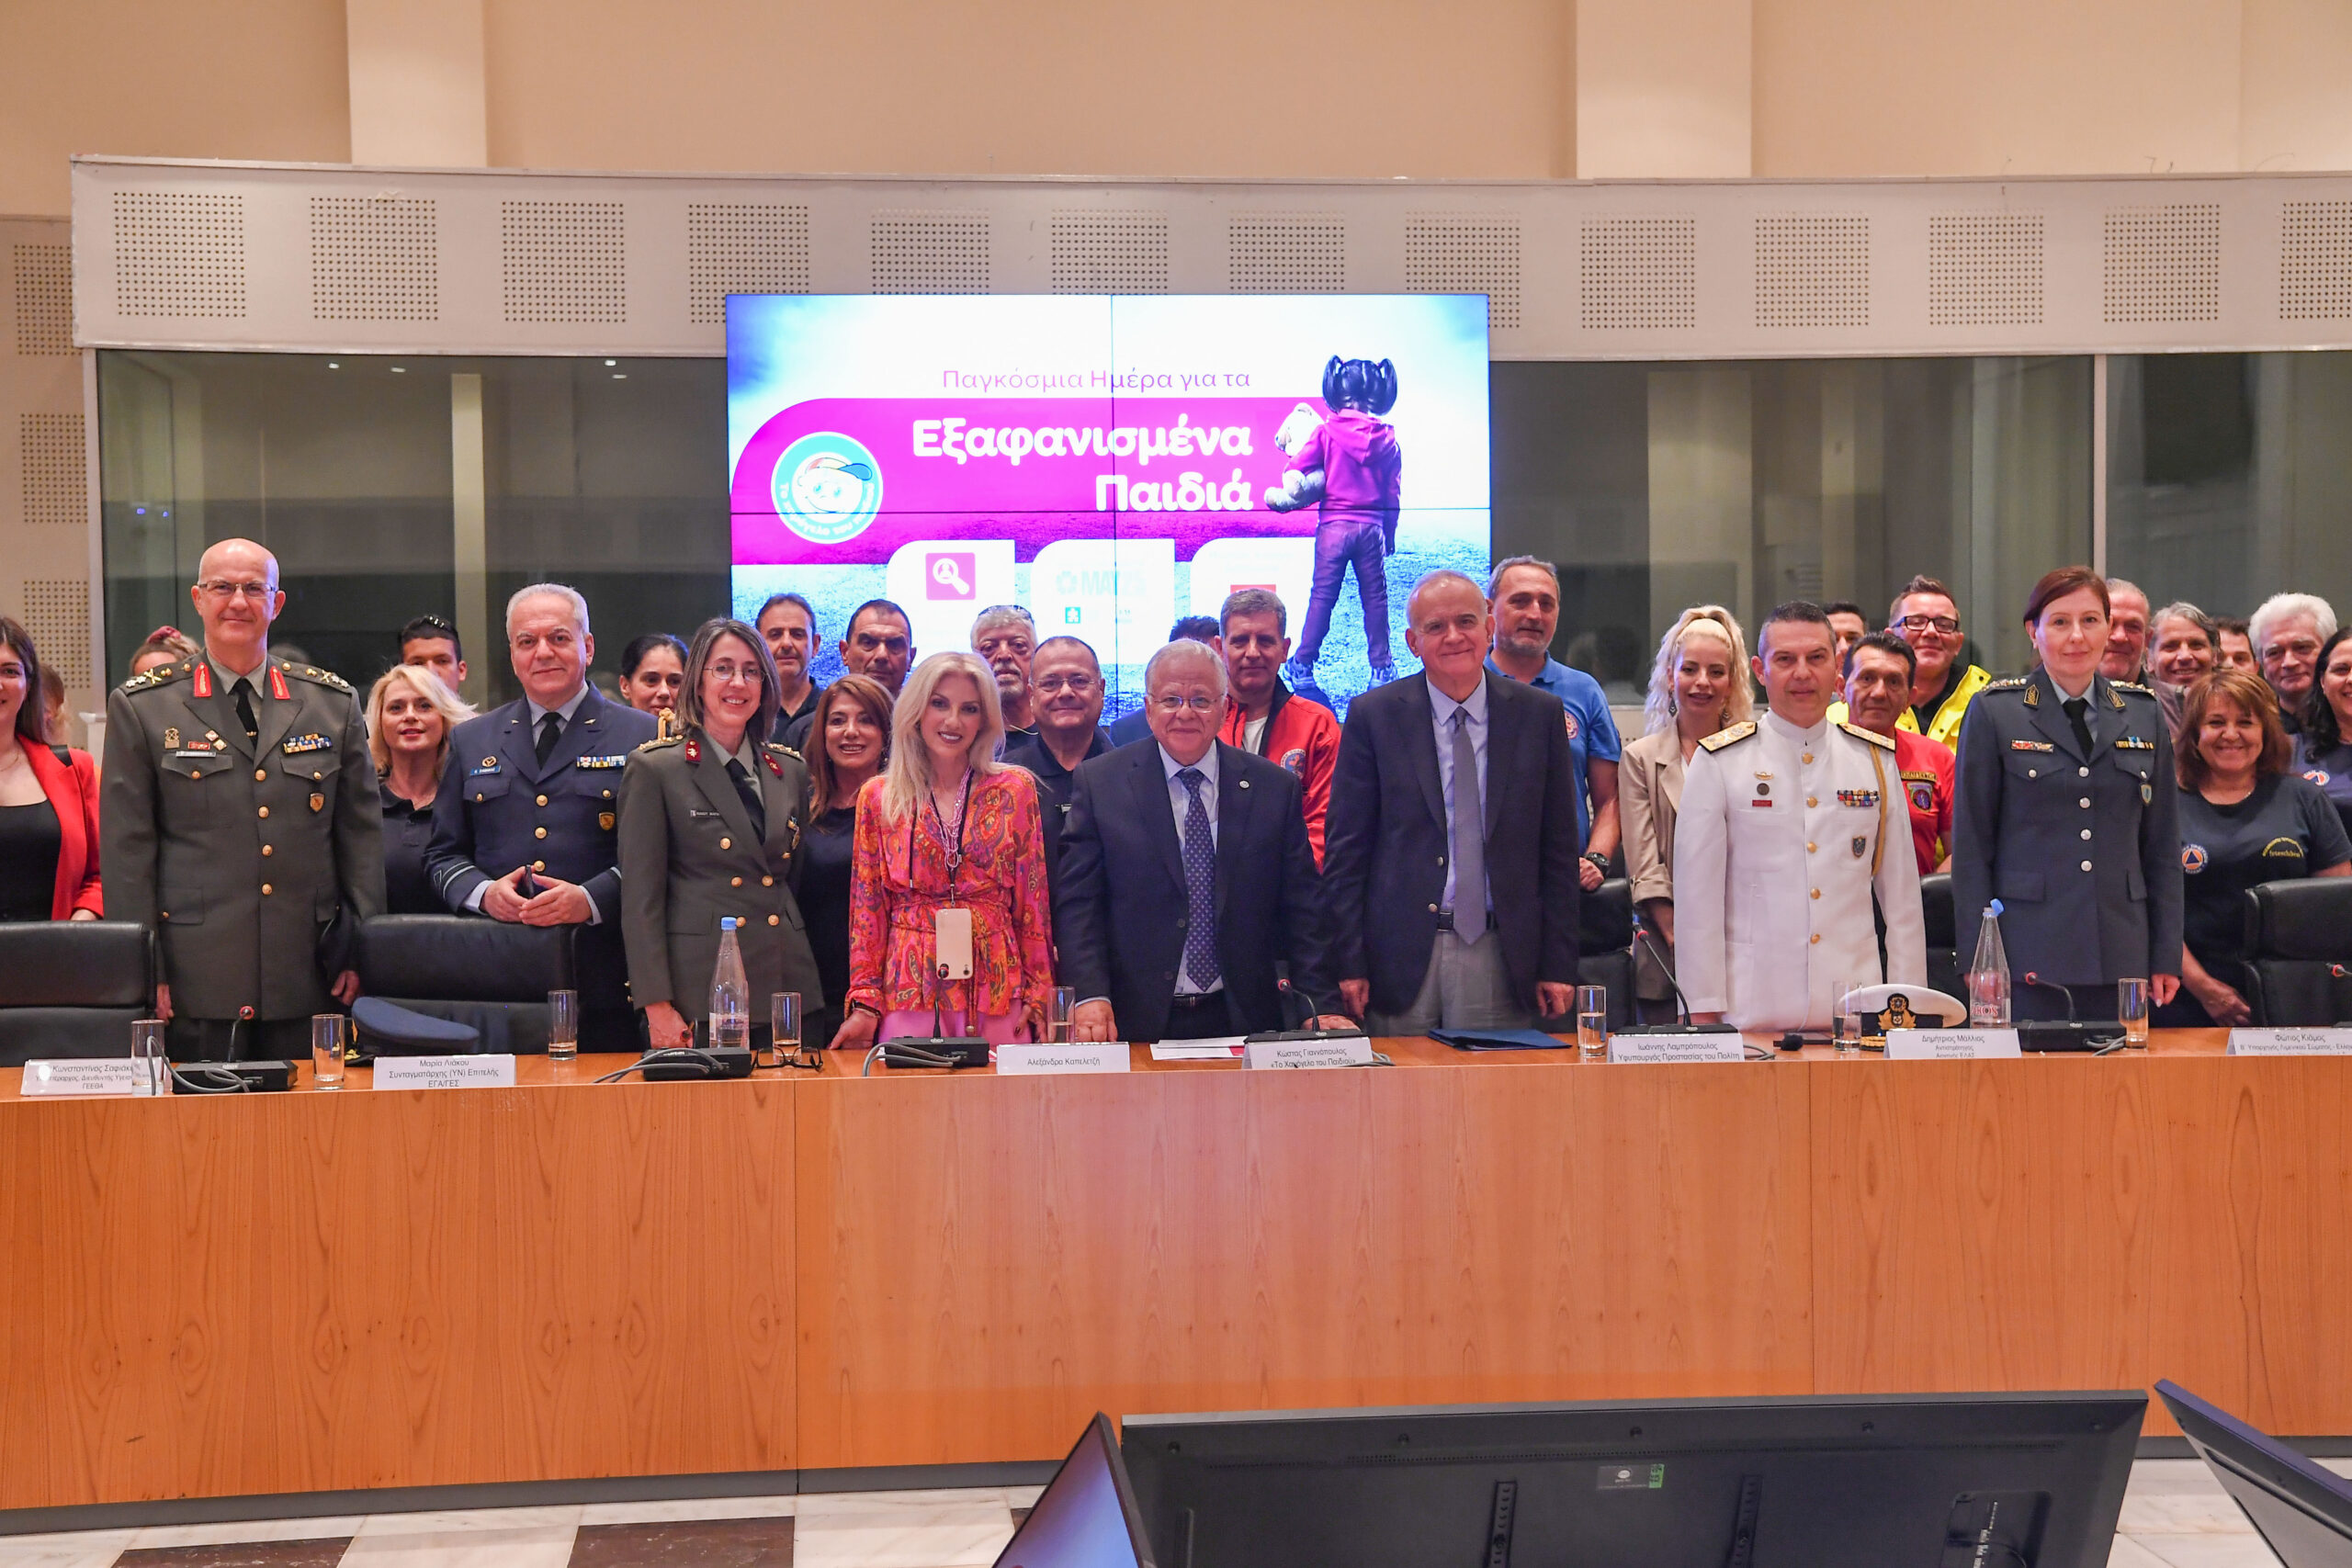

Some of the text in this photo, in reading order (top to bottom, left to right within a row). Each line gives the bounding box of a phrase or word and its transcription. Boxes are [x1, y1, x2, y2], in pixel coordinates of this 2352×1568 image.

[943, 367, 1250, 393] Παγκόσμια Ημέρα για τα
[913, 412, 1254, 467] Εξαφανισμένα
[1095, 468, 1254, 512] Παιδιά
[1922, 1034, 1956, 1044] Δημήτριος
[1637, 1042, 1718, 1052] Ιωάννης Λαμπρόπουλος
[1276, 1048, 1347, 1058] Κώστας Γιαννόπουλος
[1618, 1054, 1661, 1063] Υφυπουργός
[1662, 1053, 1703, 1062] Προστασίας
[1717, 1051, 1740, 1061] Πολίτη
[419, 1058, 469, 1067] Μαρία Λιάκου
[1027, 1056, 1101, 1067] Αλεξάνδρα Καπελετζή
[52, 1065, 103, 1074] Κωνσταντίνος
[389, 1067, 499, 1079] Συνταγματάρχης (ΥΝ) Επιτελής
[428, 1079, 459, 1088] ΕΓΑ/ΓΕΣ
